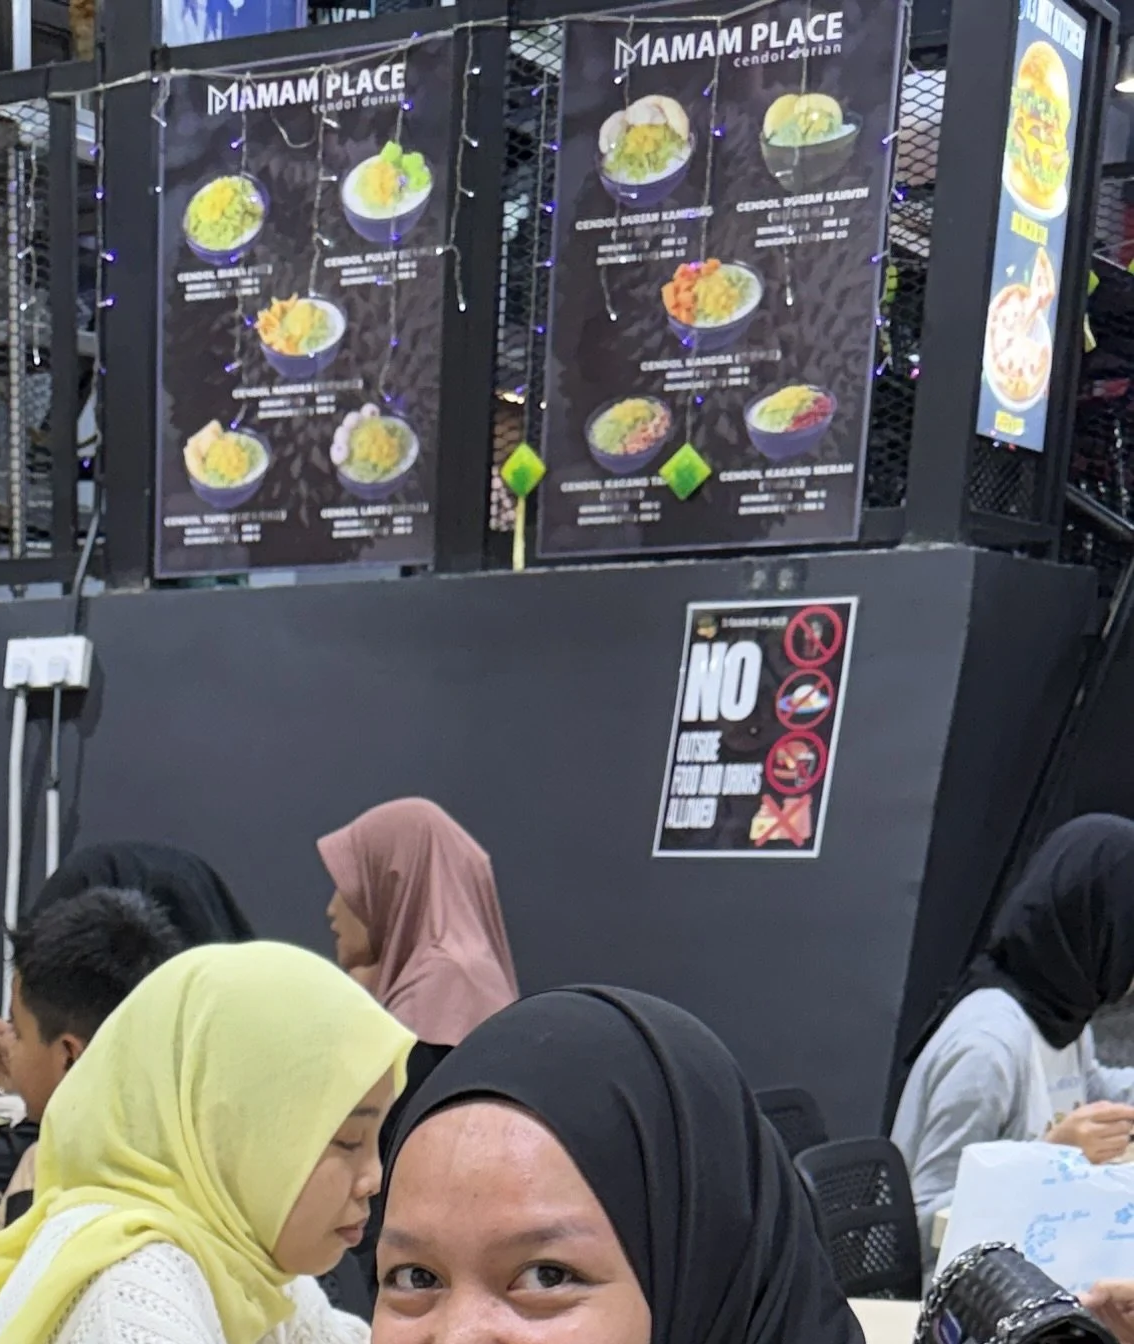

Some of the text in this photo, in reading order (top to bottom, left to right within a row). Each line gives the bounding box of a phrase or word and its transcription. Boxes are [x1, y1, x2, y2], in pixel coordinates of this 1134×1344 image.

[614, 12, 844, 71] MAMAM PLACE
[733, 52, 785, 68] cendol
[207, 63, 407, 116] MAMAM PLACE
[681, 641, 763, 722] NO
